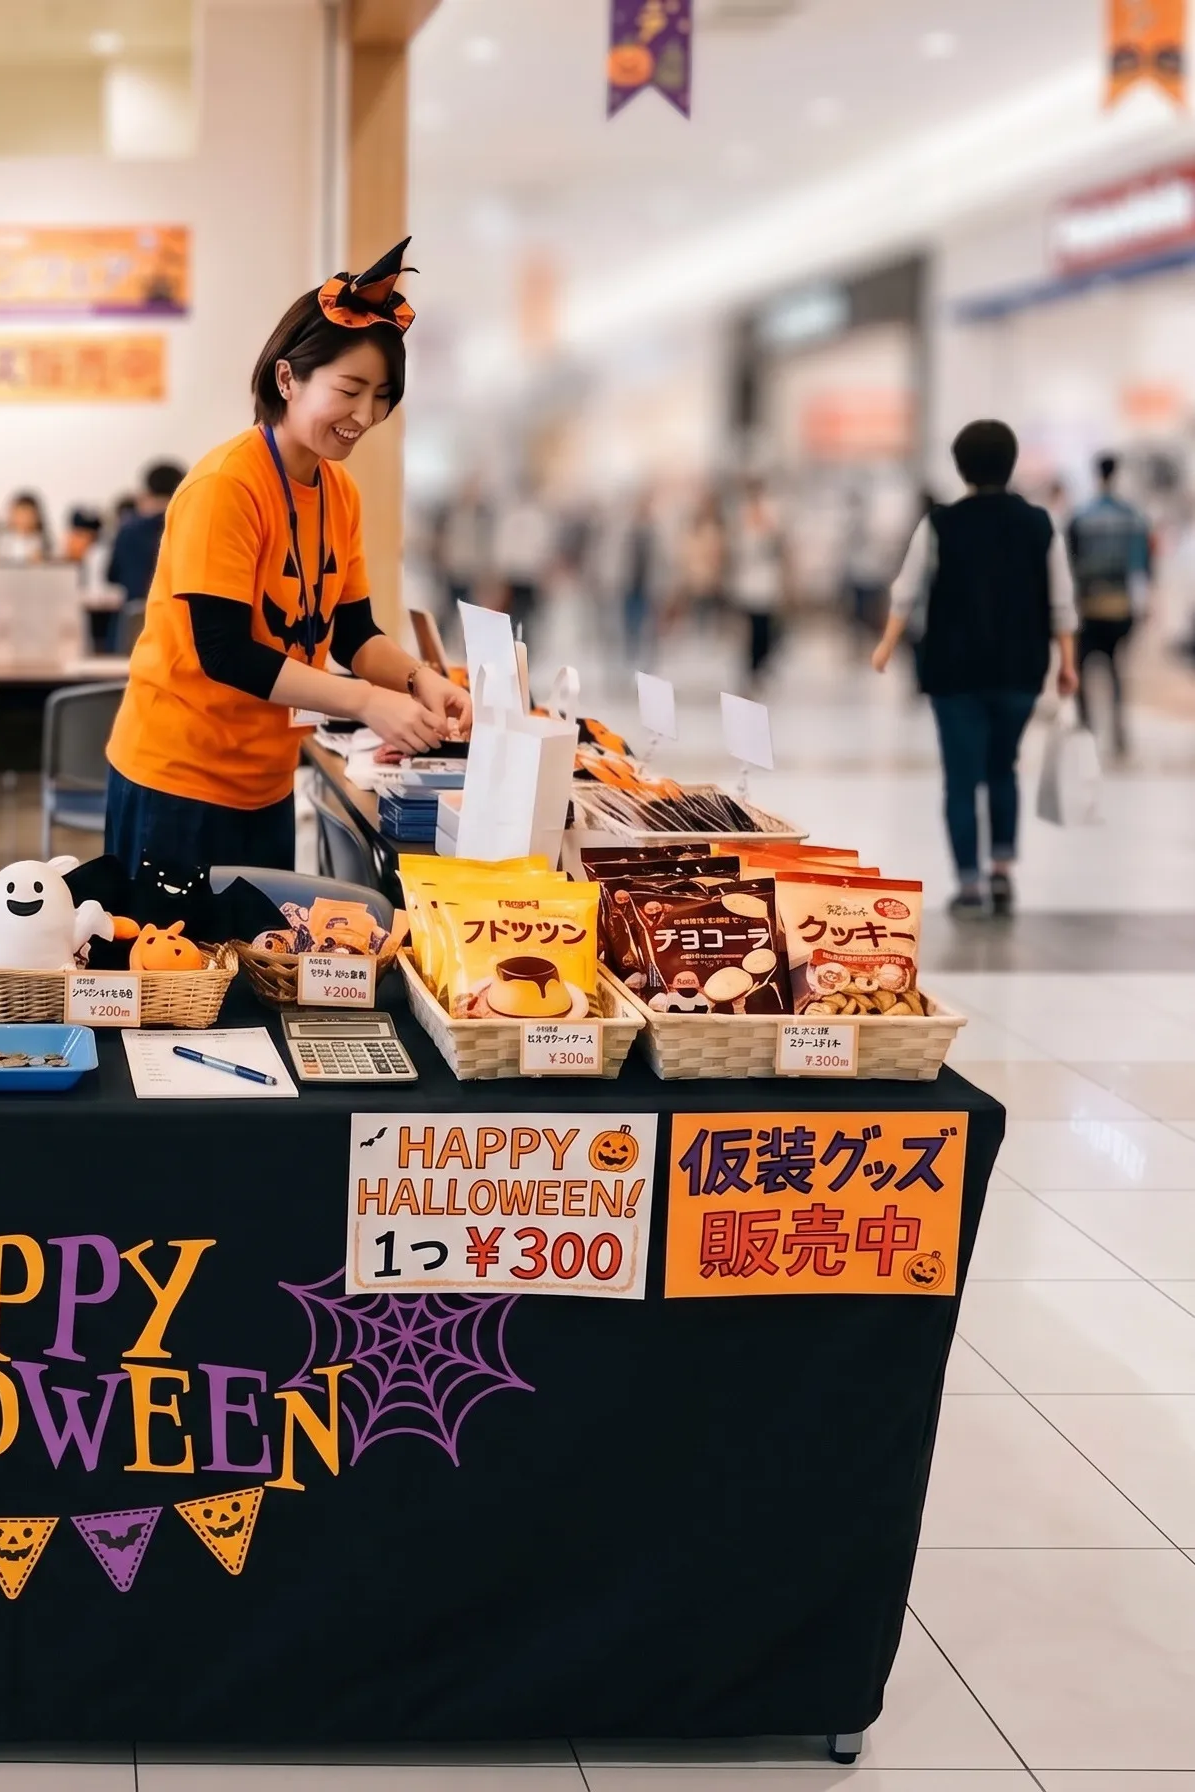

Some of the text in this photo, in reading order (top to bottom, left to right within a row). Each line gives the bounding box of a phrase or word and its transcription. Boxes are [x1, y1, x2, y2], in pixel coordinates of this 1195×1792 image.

[798, 915, 916, 948] クッキー
[398, 1126, 580, 1170] HAPPY
[678, 1124, 958, 1196] 仮装グッズ
[357, 1178, 646, 1219] HALLOWEEN!
[374, 1226, 624, 1281] 1つ ¥300
[699, 1203, 921, 1279] 販売中
